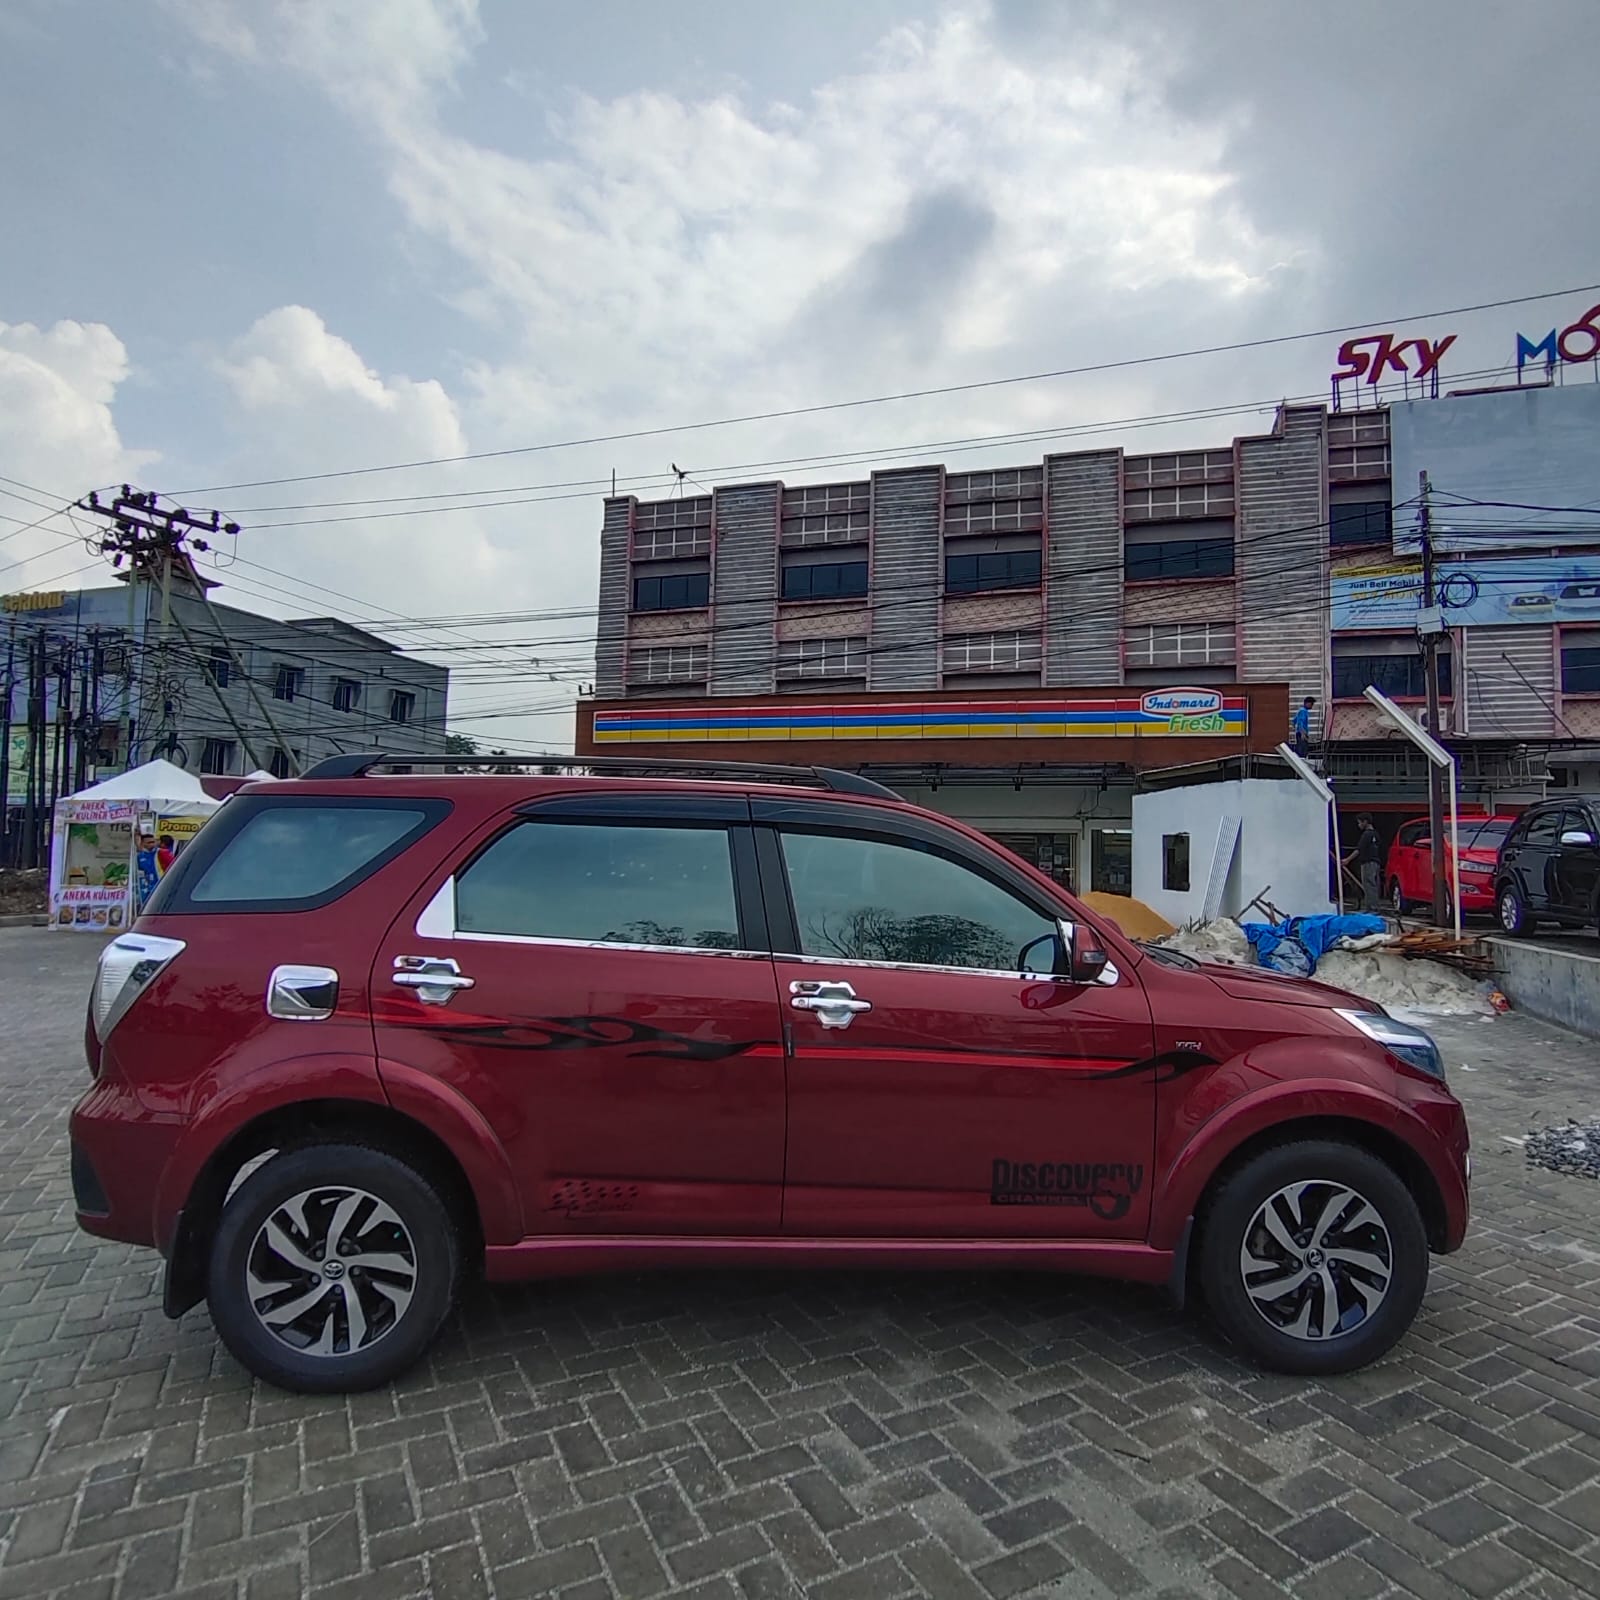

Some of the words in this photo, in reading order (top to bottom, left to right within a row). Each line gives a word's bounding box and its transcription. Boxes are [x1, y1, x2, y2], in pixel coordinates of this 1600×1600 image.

[1146, 696, 1217, 709] Indomaret
[81, 801, 106, 810] ANEKA
[75, 811, 108, 820] KULINER
[160, 820, 200, 832] Promo
[63, 890, 91, 900] ANEKA
[93, 890, 126, 901] KULINER
